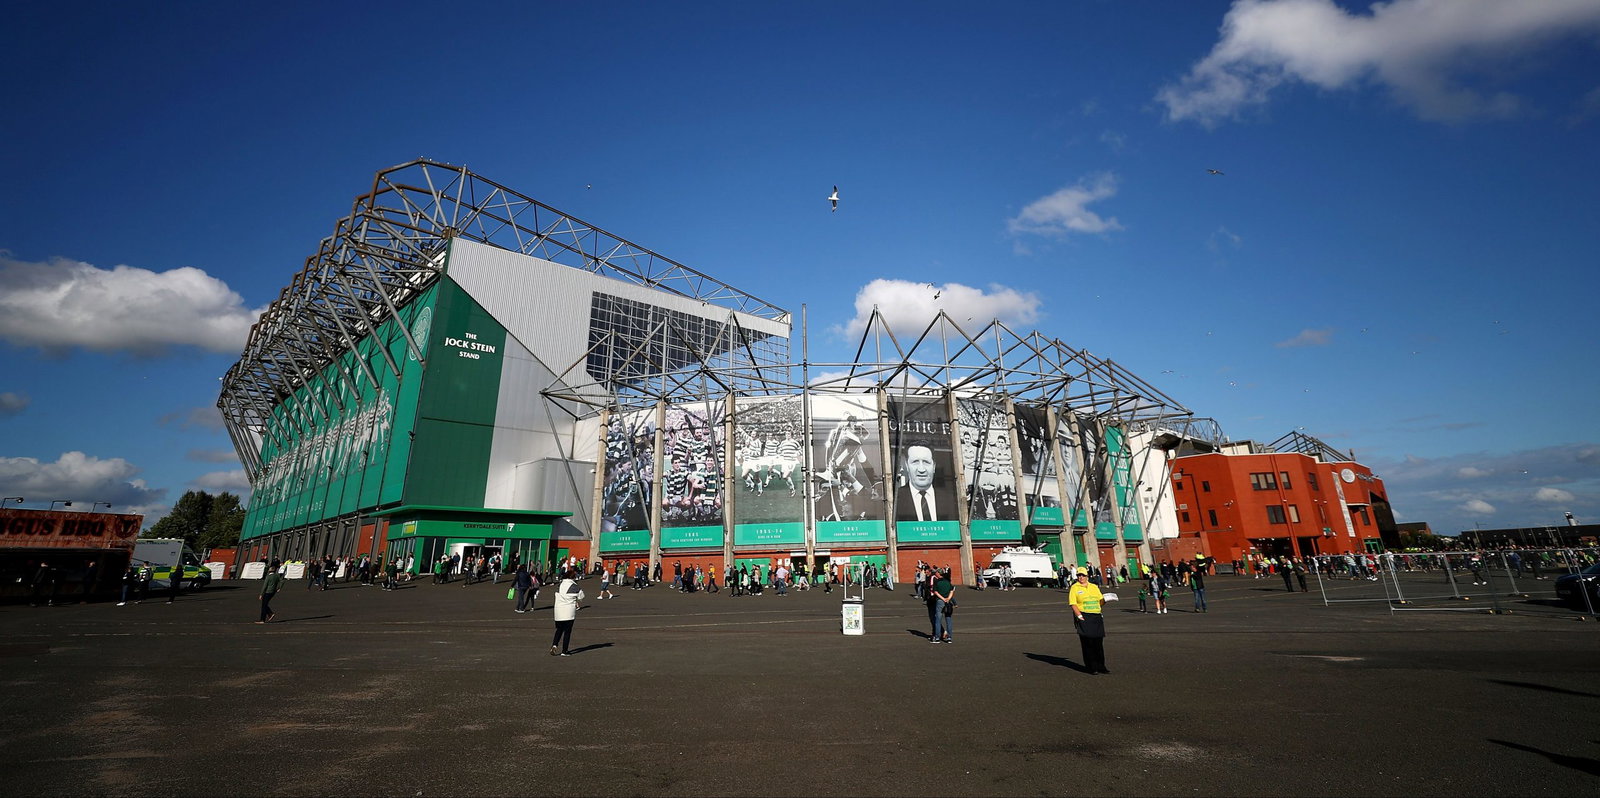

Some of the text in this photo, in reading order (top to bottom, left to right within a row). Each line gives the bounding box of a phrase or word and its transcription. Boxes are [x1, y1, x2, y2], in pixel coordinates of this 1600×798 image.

[444, 337, 496, 354] JOCK STEIN
[459, 351, 480, 360] STAND
[889, 419, 937, 435] CELTIC
[59, 519, 105, 536] BBQ
